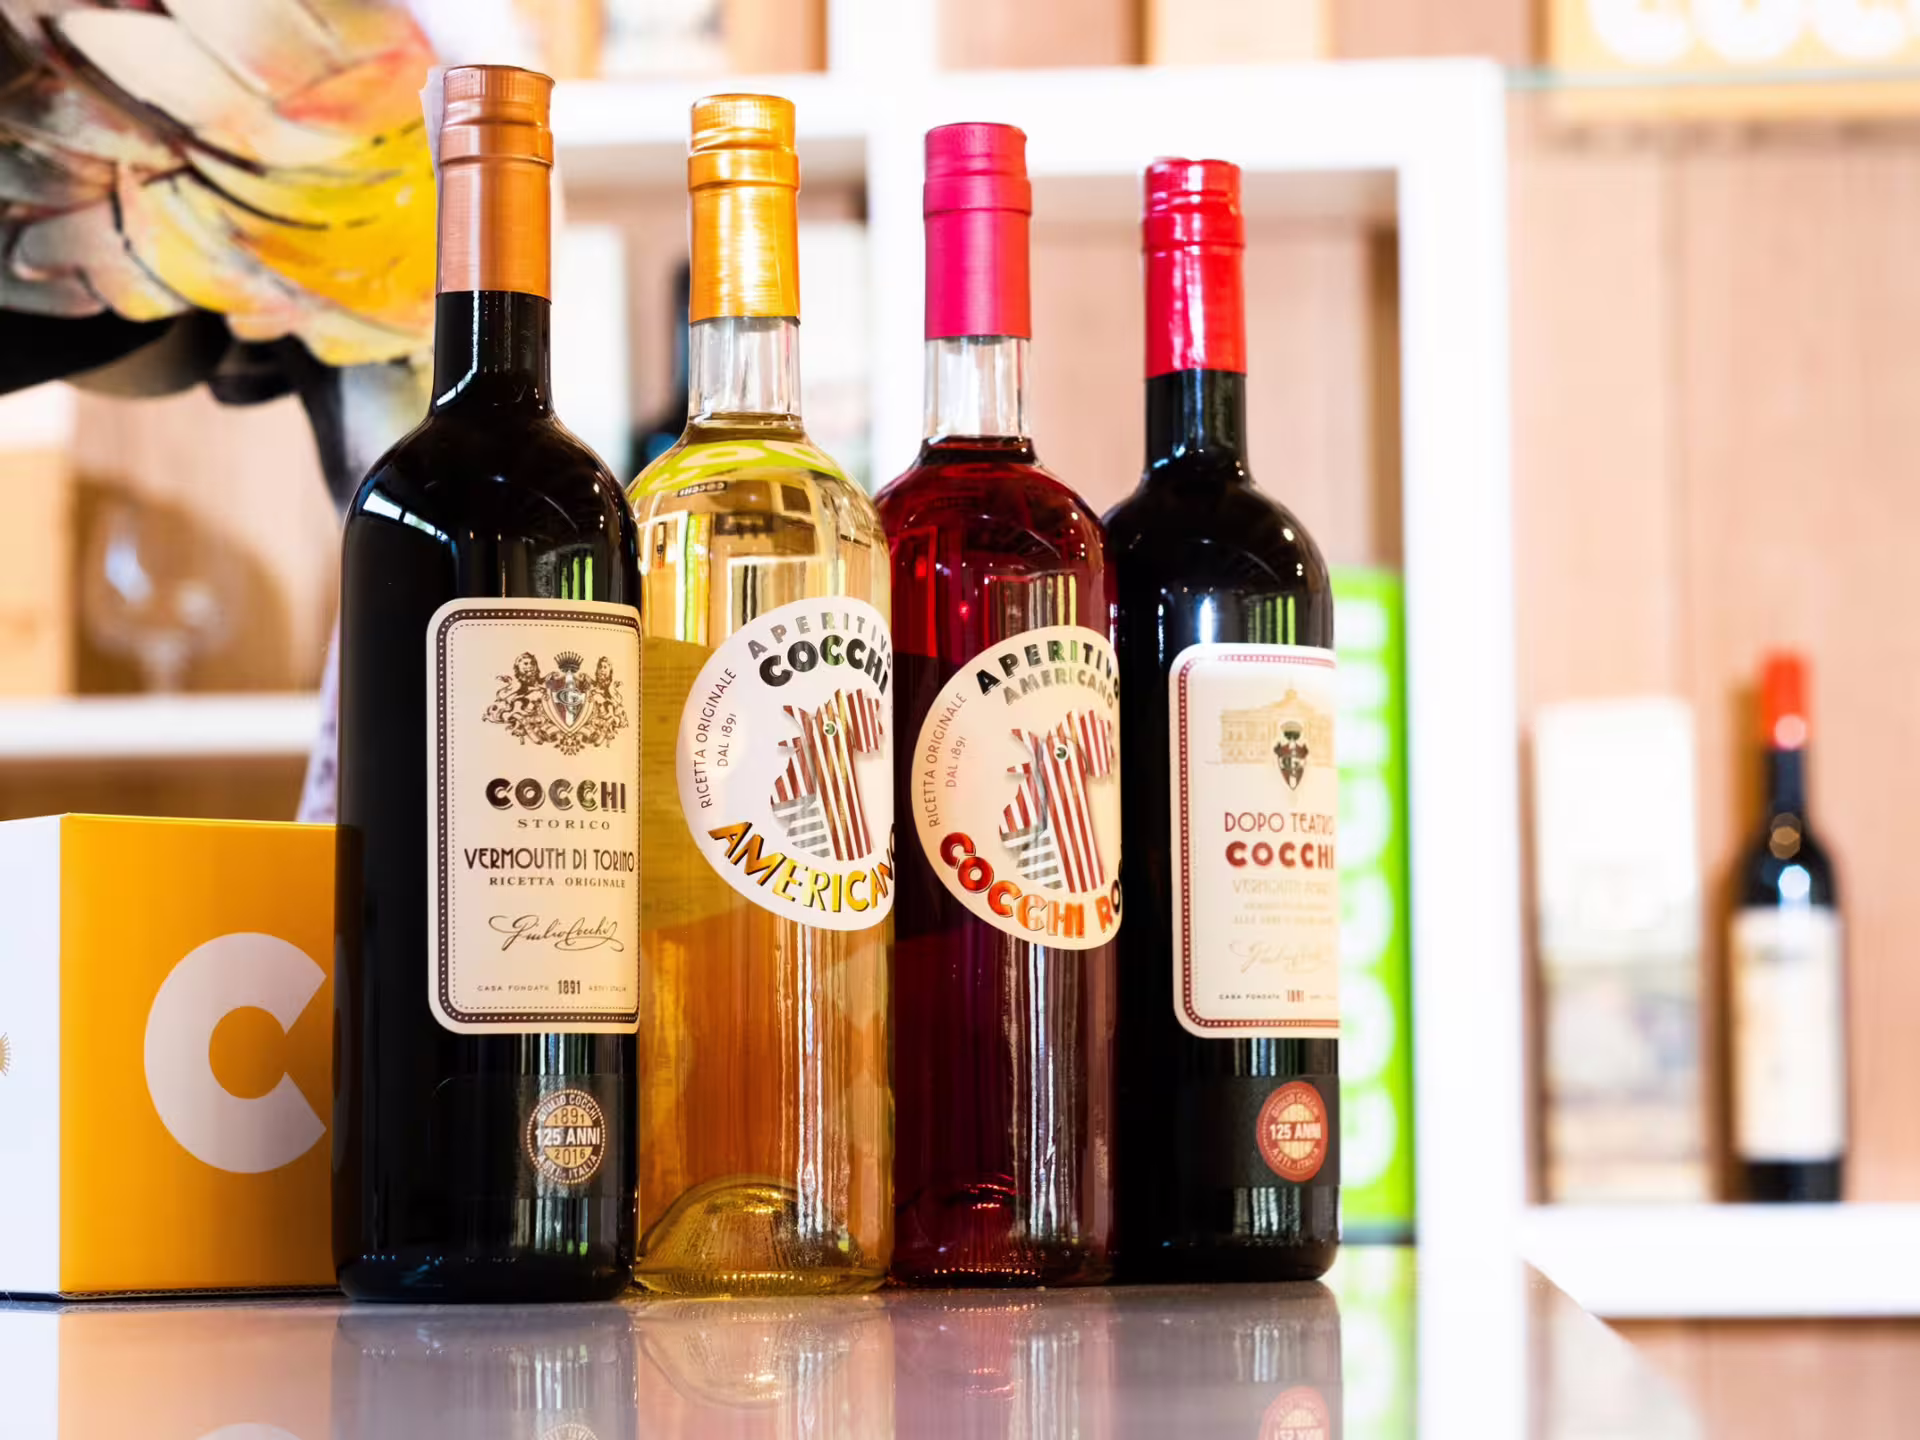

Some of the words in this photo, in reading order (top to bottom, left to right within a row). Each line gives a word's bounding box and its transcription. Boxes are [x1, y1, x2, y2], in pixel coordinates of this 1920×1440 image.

[748, 612, 892, 670] APERITIVO
[759, 635, 889, 696] COCCHI
[976, 640, 1120, 699] APERITIVO
[695, 667, 737, 743] ORIGINALE
[1002, 667, 1114, 710] AMERICANO
[717, 741, 730, 767] DAL
[724, 713, 738, 738] 1891
[926, 692, 967, 763] ORIGINALE
[694, 749, 713, 808] RICETTA
[945, 762, 958, 788] DAL
[953, 736, 967, 761] 1891
[485, 778, 626, 813] COCCHI
[923, 769, 940, 827] RICETTA
[517, 818, 610, 830] STORICO
[1224, 812, 1284, 832] DOPO
[464, 848, 566, 870] VERMOUTH
[573, 849, 587, 870] DI
[593, 849, 635, 873] TORINO
[1225, 840, 1334, 869] COCCHI
[489, 877, 555, 886] RICETTA
[565, 877, 626, 889] ORIGINALE
[940, 832, 1085, 938] COCCHI
[557, 979, 581, 995] 1891
[144, 932, 327, 1174] C
[537, 1095, 566, 1121] GIULIO
[569, 1095, 598, 1120] COCCHI
[554, 1107, 585, 1124] 1891
[535, 1128, 561, 1146] 125
[565, 1127, 600, 1145] ANNI
[1269, 1123, 1292, 1140] 125
[554, 1149, 586, 1167] 2016
[569, 1155, 598, 1178] ITALIA
